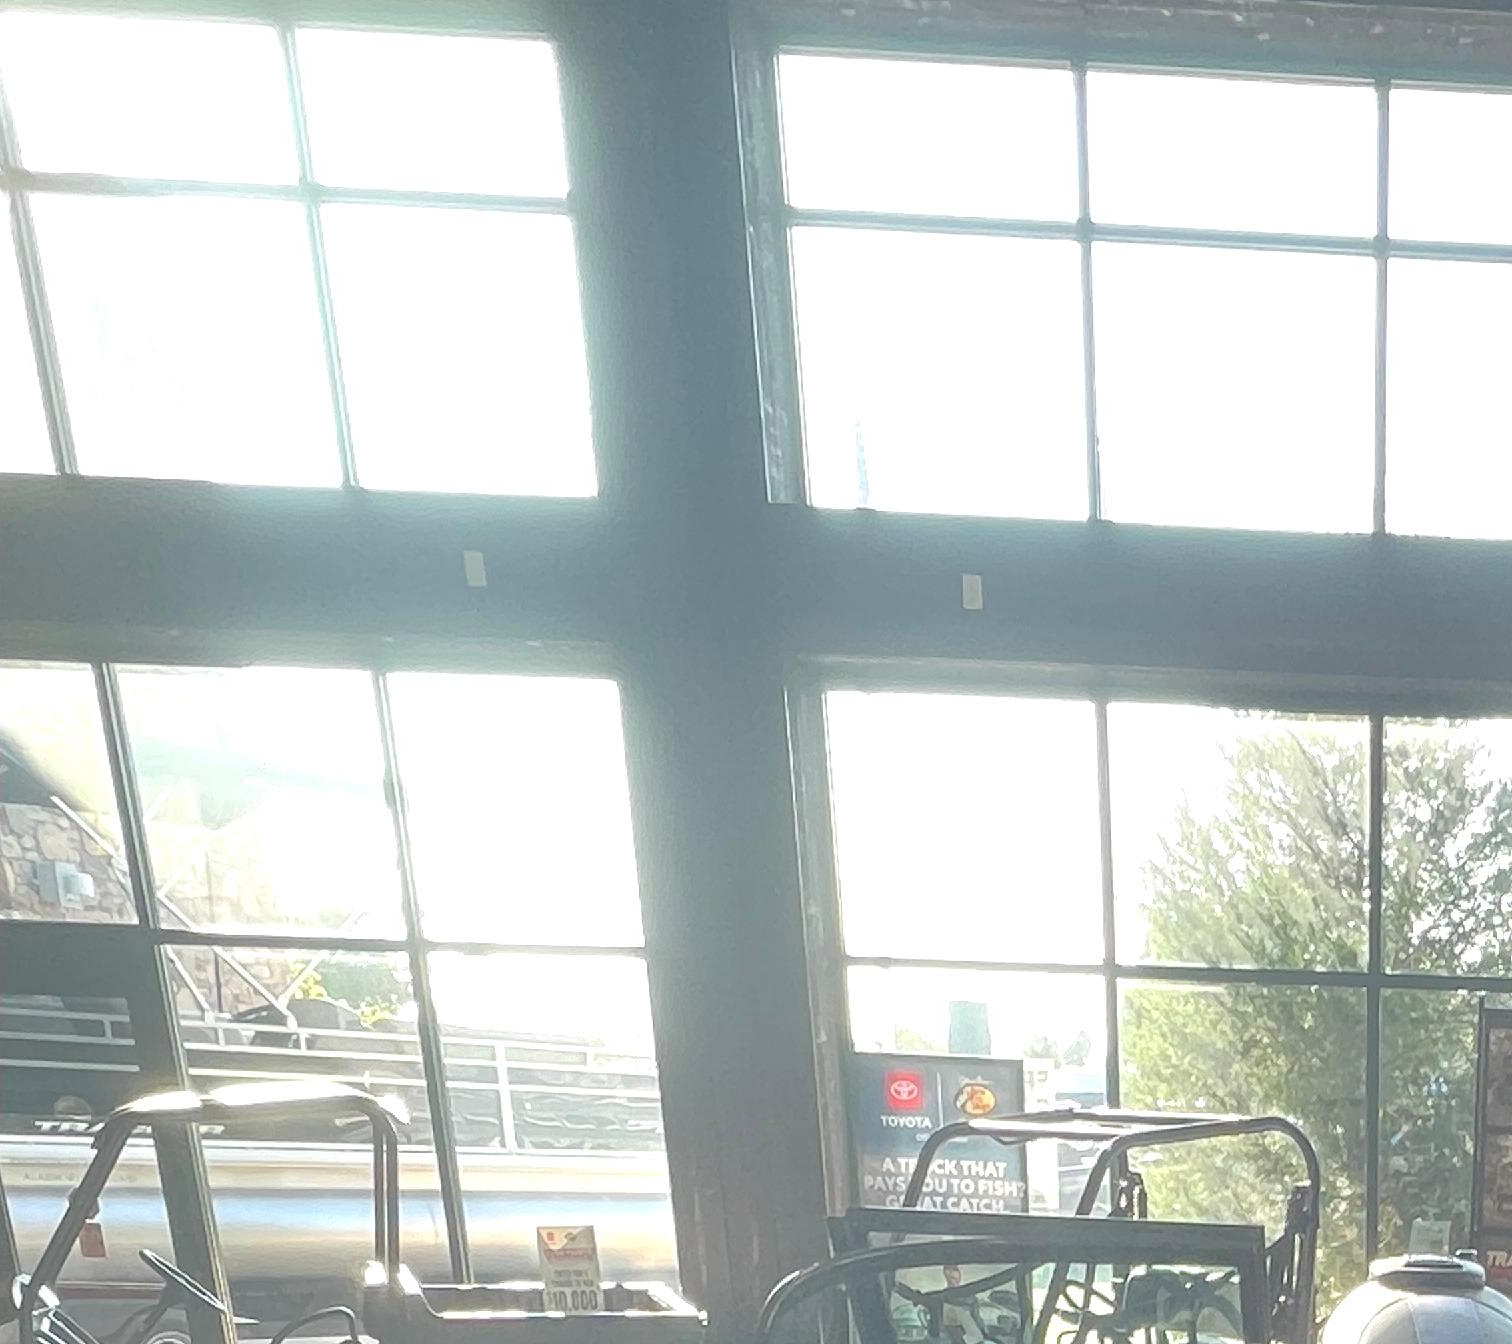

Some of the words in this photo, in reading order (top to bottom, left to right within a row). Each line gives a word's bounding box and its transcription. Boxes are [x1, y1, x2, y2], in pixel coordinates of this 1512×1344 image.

[880, 1115, 932, 1129] TOYOTA
[882, 1157, 895, 1173] A
[960, 1160, 1007, 1178] THAT
[864, 1174, 906, 1191] PAYS
[950, 1179, 975, 1195] TO
[977, 1180, 1026, 1199] FISH?
